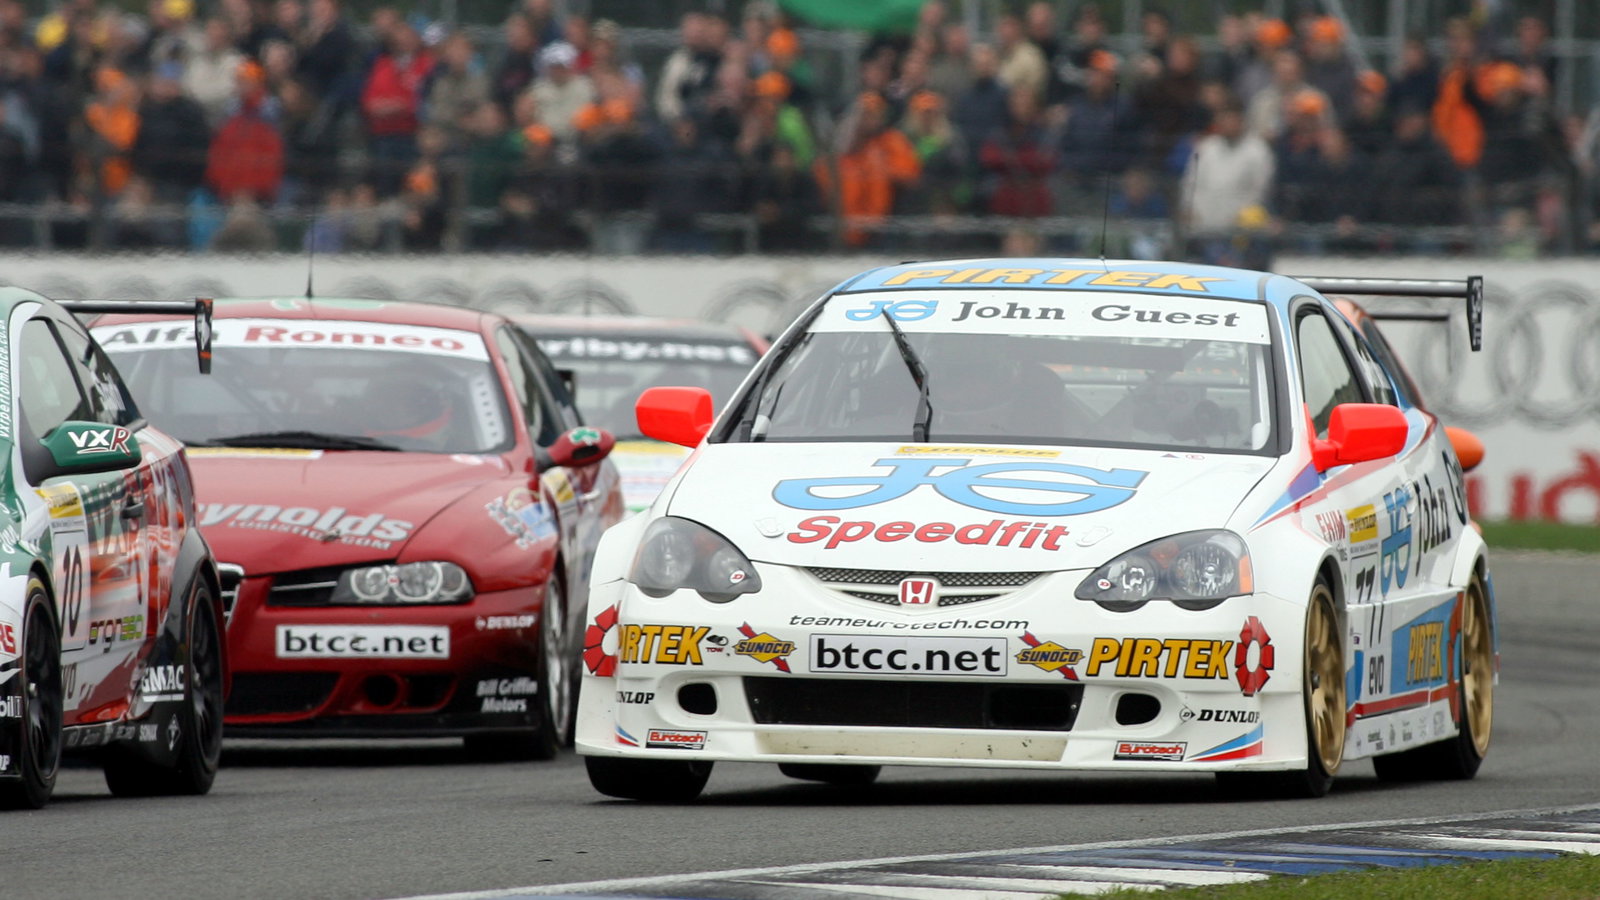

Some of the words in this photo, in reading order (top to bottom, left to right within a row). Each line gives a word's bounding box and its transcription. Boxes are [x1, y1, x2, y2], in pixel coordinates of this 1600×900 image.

[882, 268, 1238, 293] PIRTEK
[951, 301, 1066, 323] John
[1091, 303, 1241, 328] Guest
[243, 326, 465, 351] Romeo
[68, 427, 132, 457] VXR
[771, 459, 1151, 517] JG
[786, 515, 1070, 551] Speedfit
[1413, 473, 1451, 577] John
[62, 545, 83, 637] 10
[1355, 565, 1385, 648] 77
[789, 614, 1030, 630] teameurotech.com
[285, 630, 444, 654] btcc.net
[737, 641, 792, 654] SUNOCO
[816, 638, 1001, 672] btcc.net
[1019, 649, 1079, 662] SUNOCO
[1407, 620, 1445, 685] PIRTEK
[1085, 637, 1234, 680] PIRTEK
[142, 665, 185, 692] GMAC
[476, 678, 498, 697] Bill
[499, 676, 538, 696] Griffin
[480, 697, 527, 713] Motors
[650, 731, 704, 743] Eurotech
[1119, 743, 1183, 754] Eurotech
